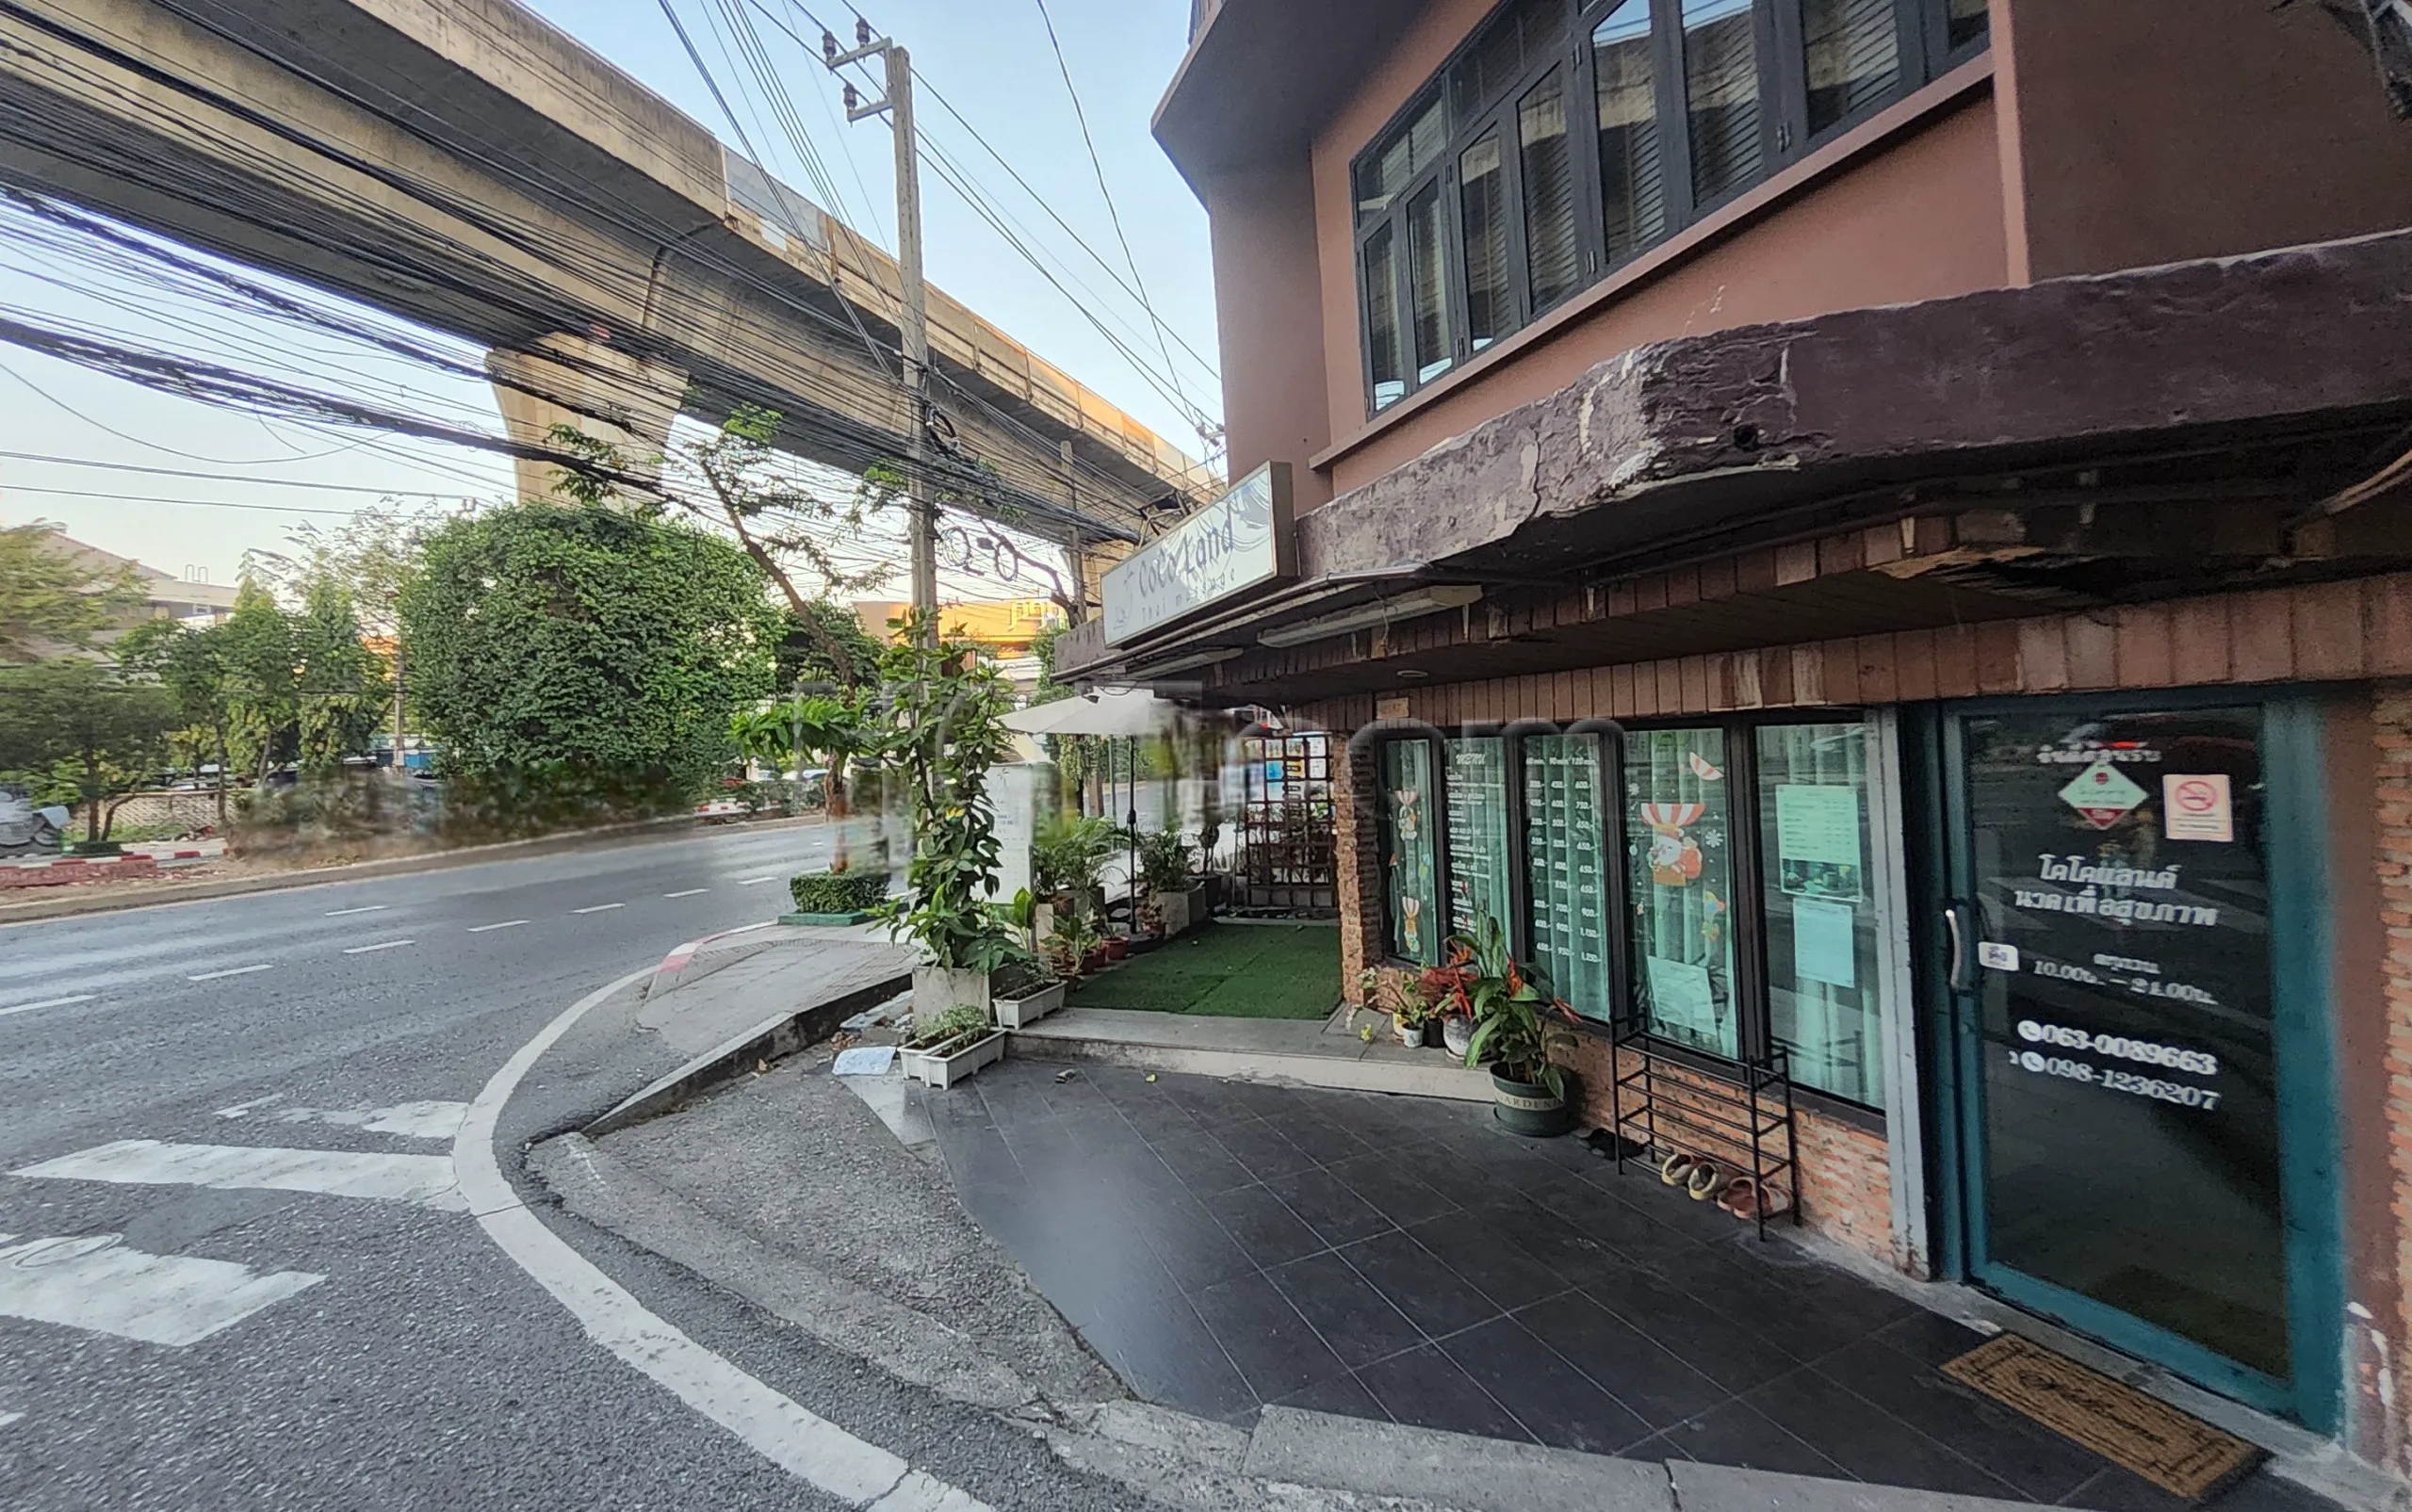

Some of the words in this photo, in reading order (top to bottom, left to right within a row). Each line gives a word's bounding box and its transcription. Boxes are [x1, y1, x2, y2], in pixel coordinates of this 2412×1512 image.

[2037, 852, 2183, 890] โคโคแลนด์
[2013, 885, 2221, 927] นวดเพื่อสุขภาพ
[2045, 1056, 2222, 1112] 098-1236207
